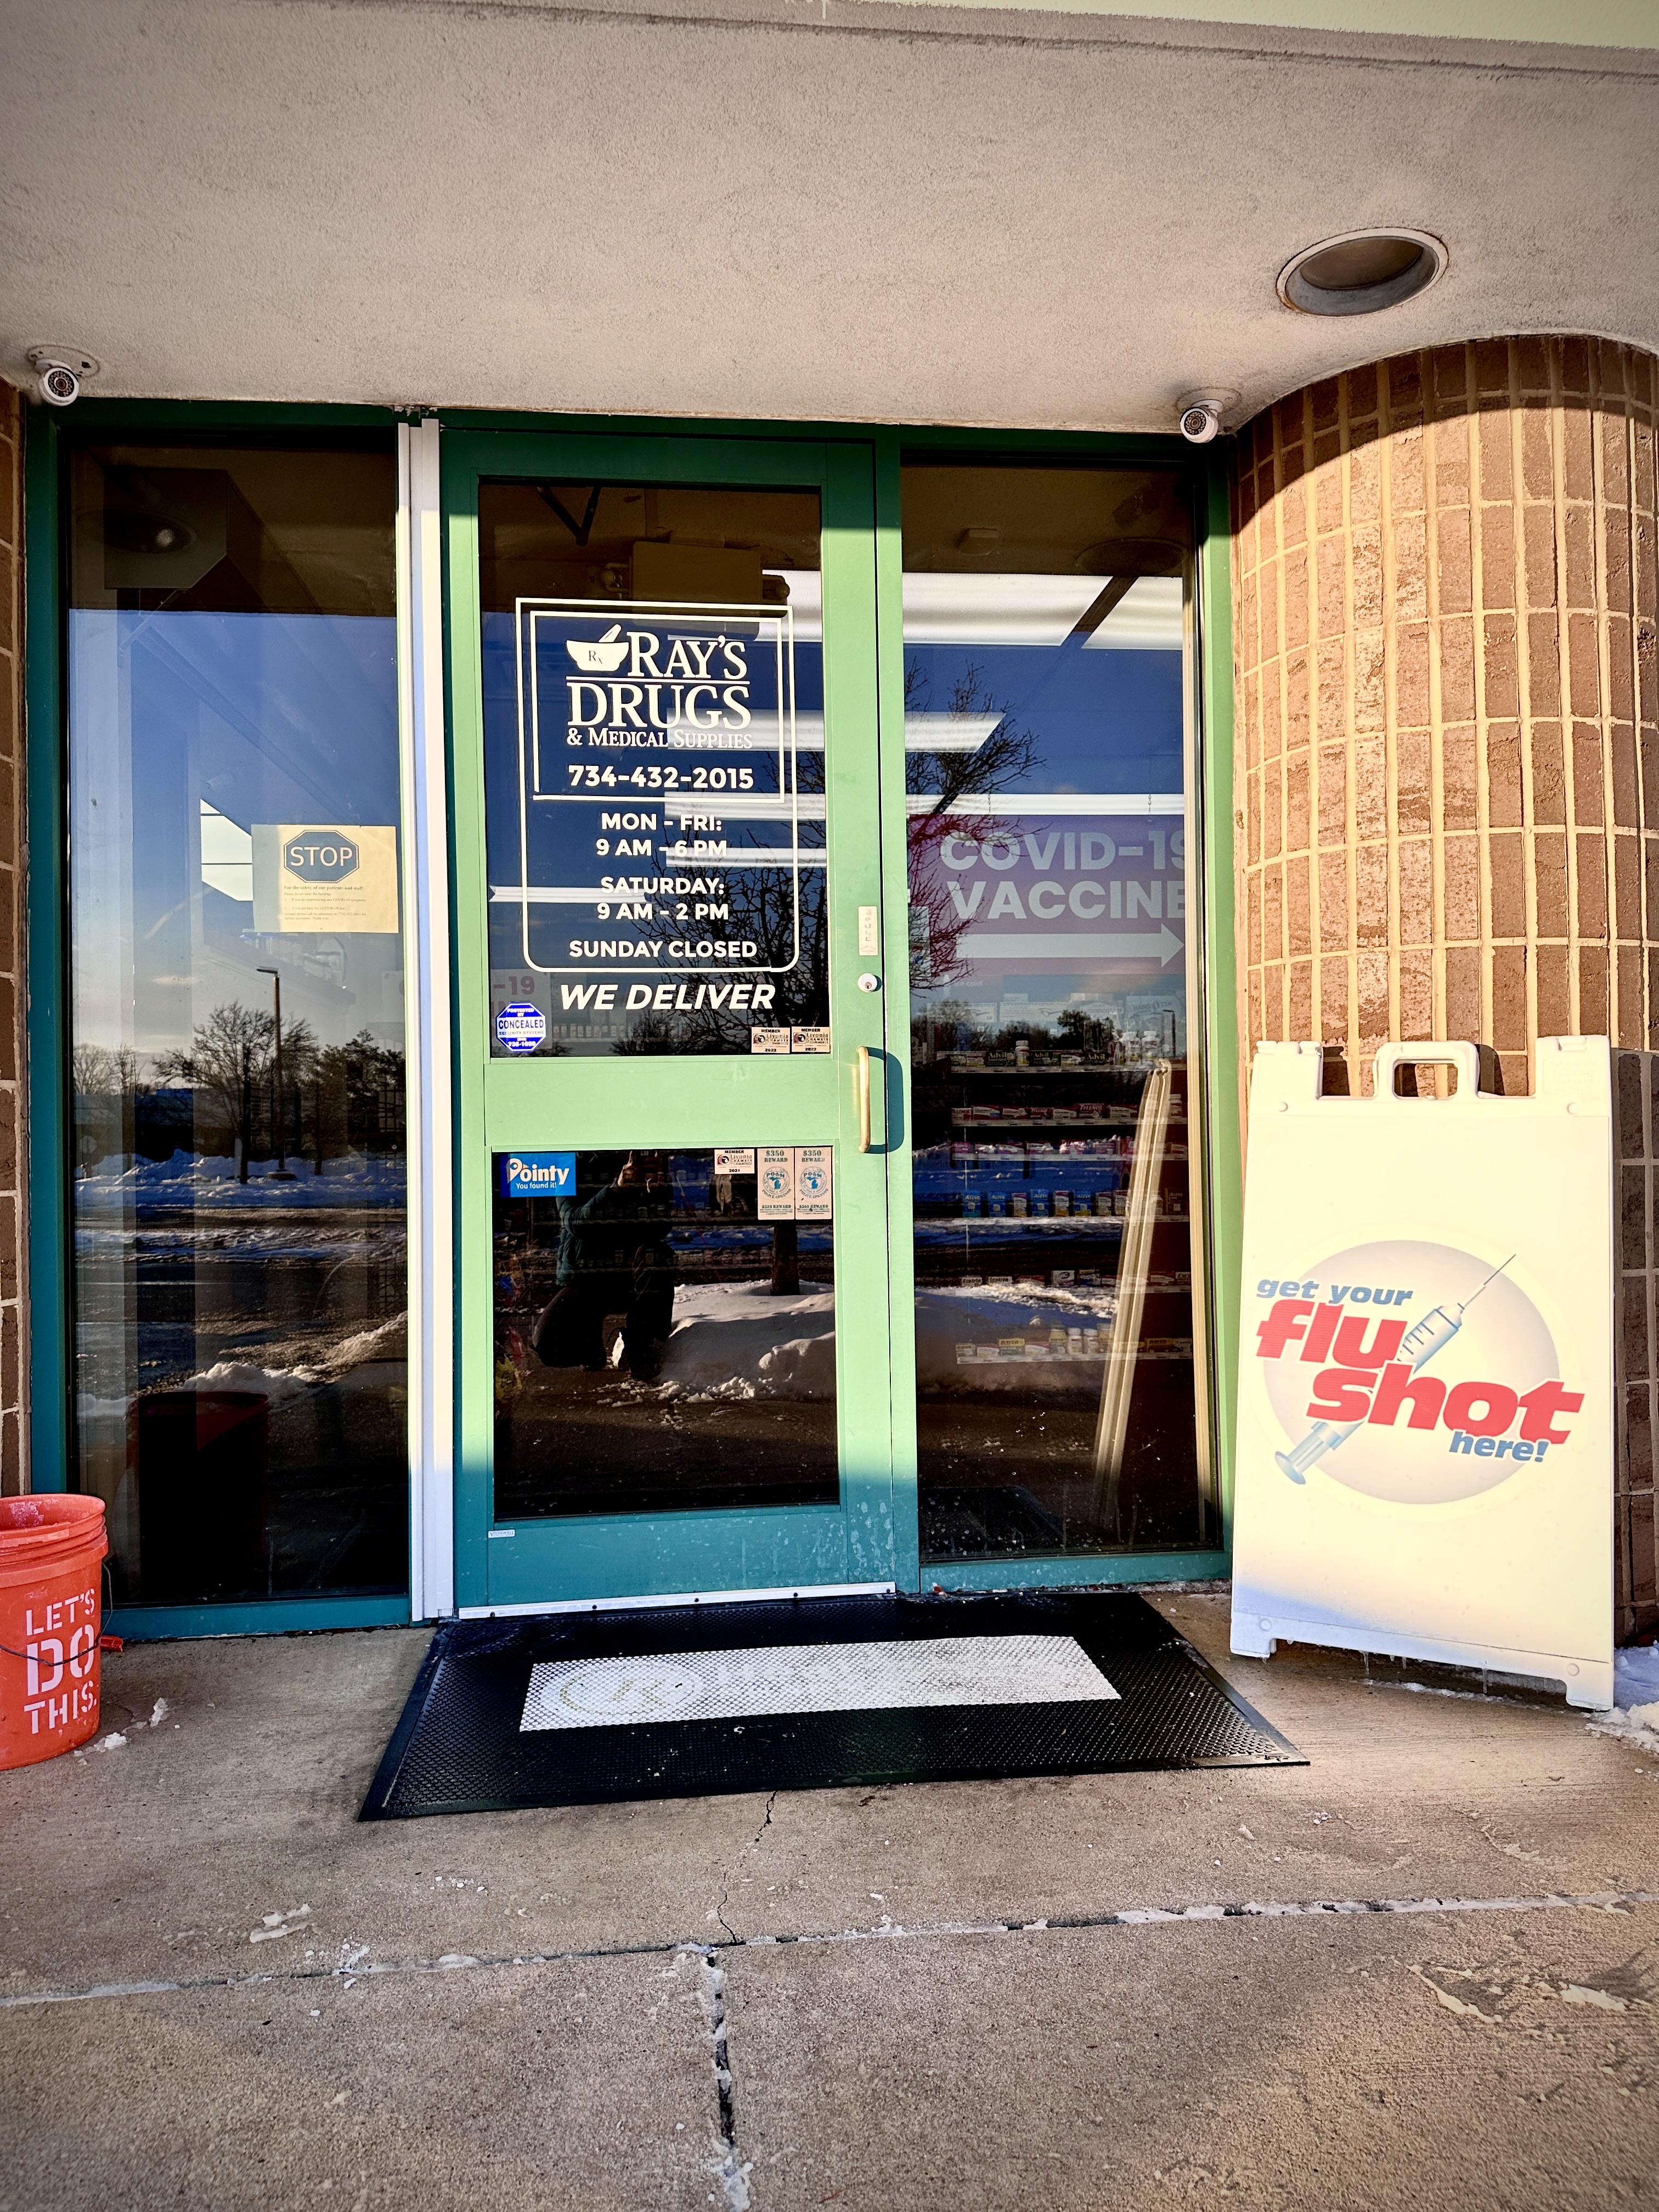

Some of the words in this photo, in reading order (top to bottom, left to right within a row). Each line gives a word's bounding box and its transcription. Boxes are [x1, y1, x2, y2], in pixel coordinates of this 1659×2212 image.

[627, 631, 748, 680] RAY'S
[566, 682, 752, 730] DRUGS
[567, 727, 583, 746] &
[589, 727, 668, 747] MEDICAL
[674, 729, 752, 748] SUPPLIES
[568, 765, 753, 789] 734-432-2015
[601, 813, 656, 831] MON
[680, 814, 721, 831] FRI:
[291, 847, 352, 866] STOP
[596, 839, 610, 856] 9
[615, 839, 651, 856] AM
[675, 840, 686, 856] 6
[694, 840, 727, 856] PM
[601, 877, 724, 895] SATURDAY:
[597, 903, 610, 919] 9
[617, 904, 652, 919] AM
[676, 904, 688, 920] 2
[696, 904, 728, 920] PM
[947, 881, 1184, 919] VACCINE
[569, 941, 663, 958] SUNDAY
[669, 941, 757, 958] CLOSED
[561, 984, 618, 1010] WE
[626, 984, 775, 1009] DELIVER
[499, 1020, 543, 1029] CONCEALED
[506, 1158, 569, 1185] Pointy
[1256, 1279, 1320, 1300] get
[1328, 1284, 1413, 1306] your
[1256, 1299, 1408, 1369] flu
[1306, 1362, 1585, 1444] shot
[1449, 1431, 1549, 1463] here!
[26, 1588, 95, 1636] LET'S
[27, 1623, 94, 1696] DO
[24, 1680, 97, 1734] THIS.
